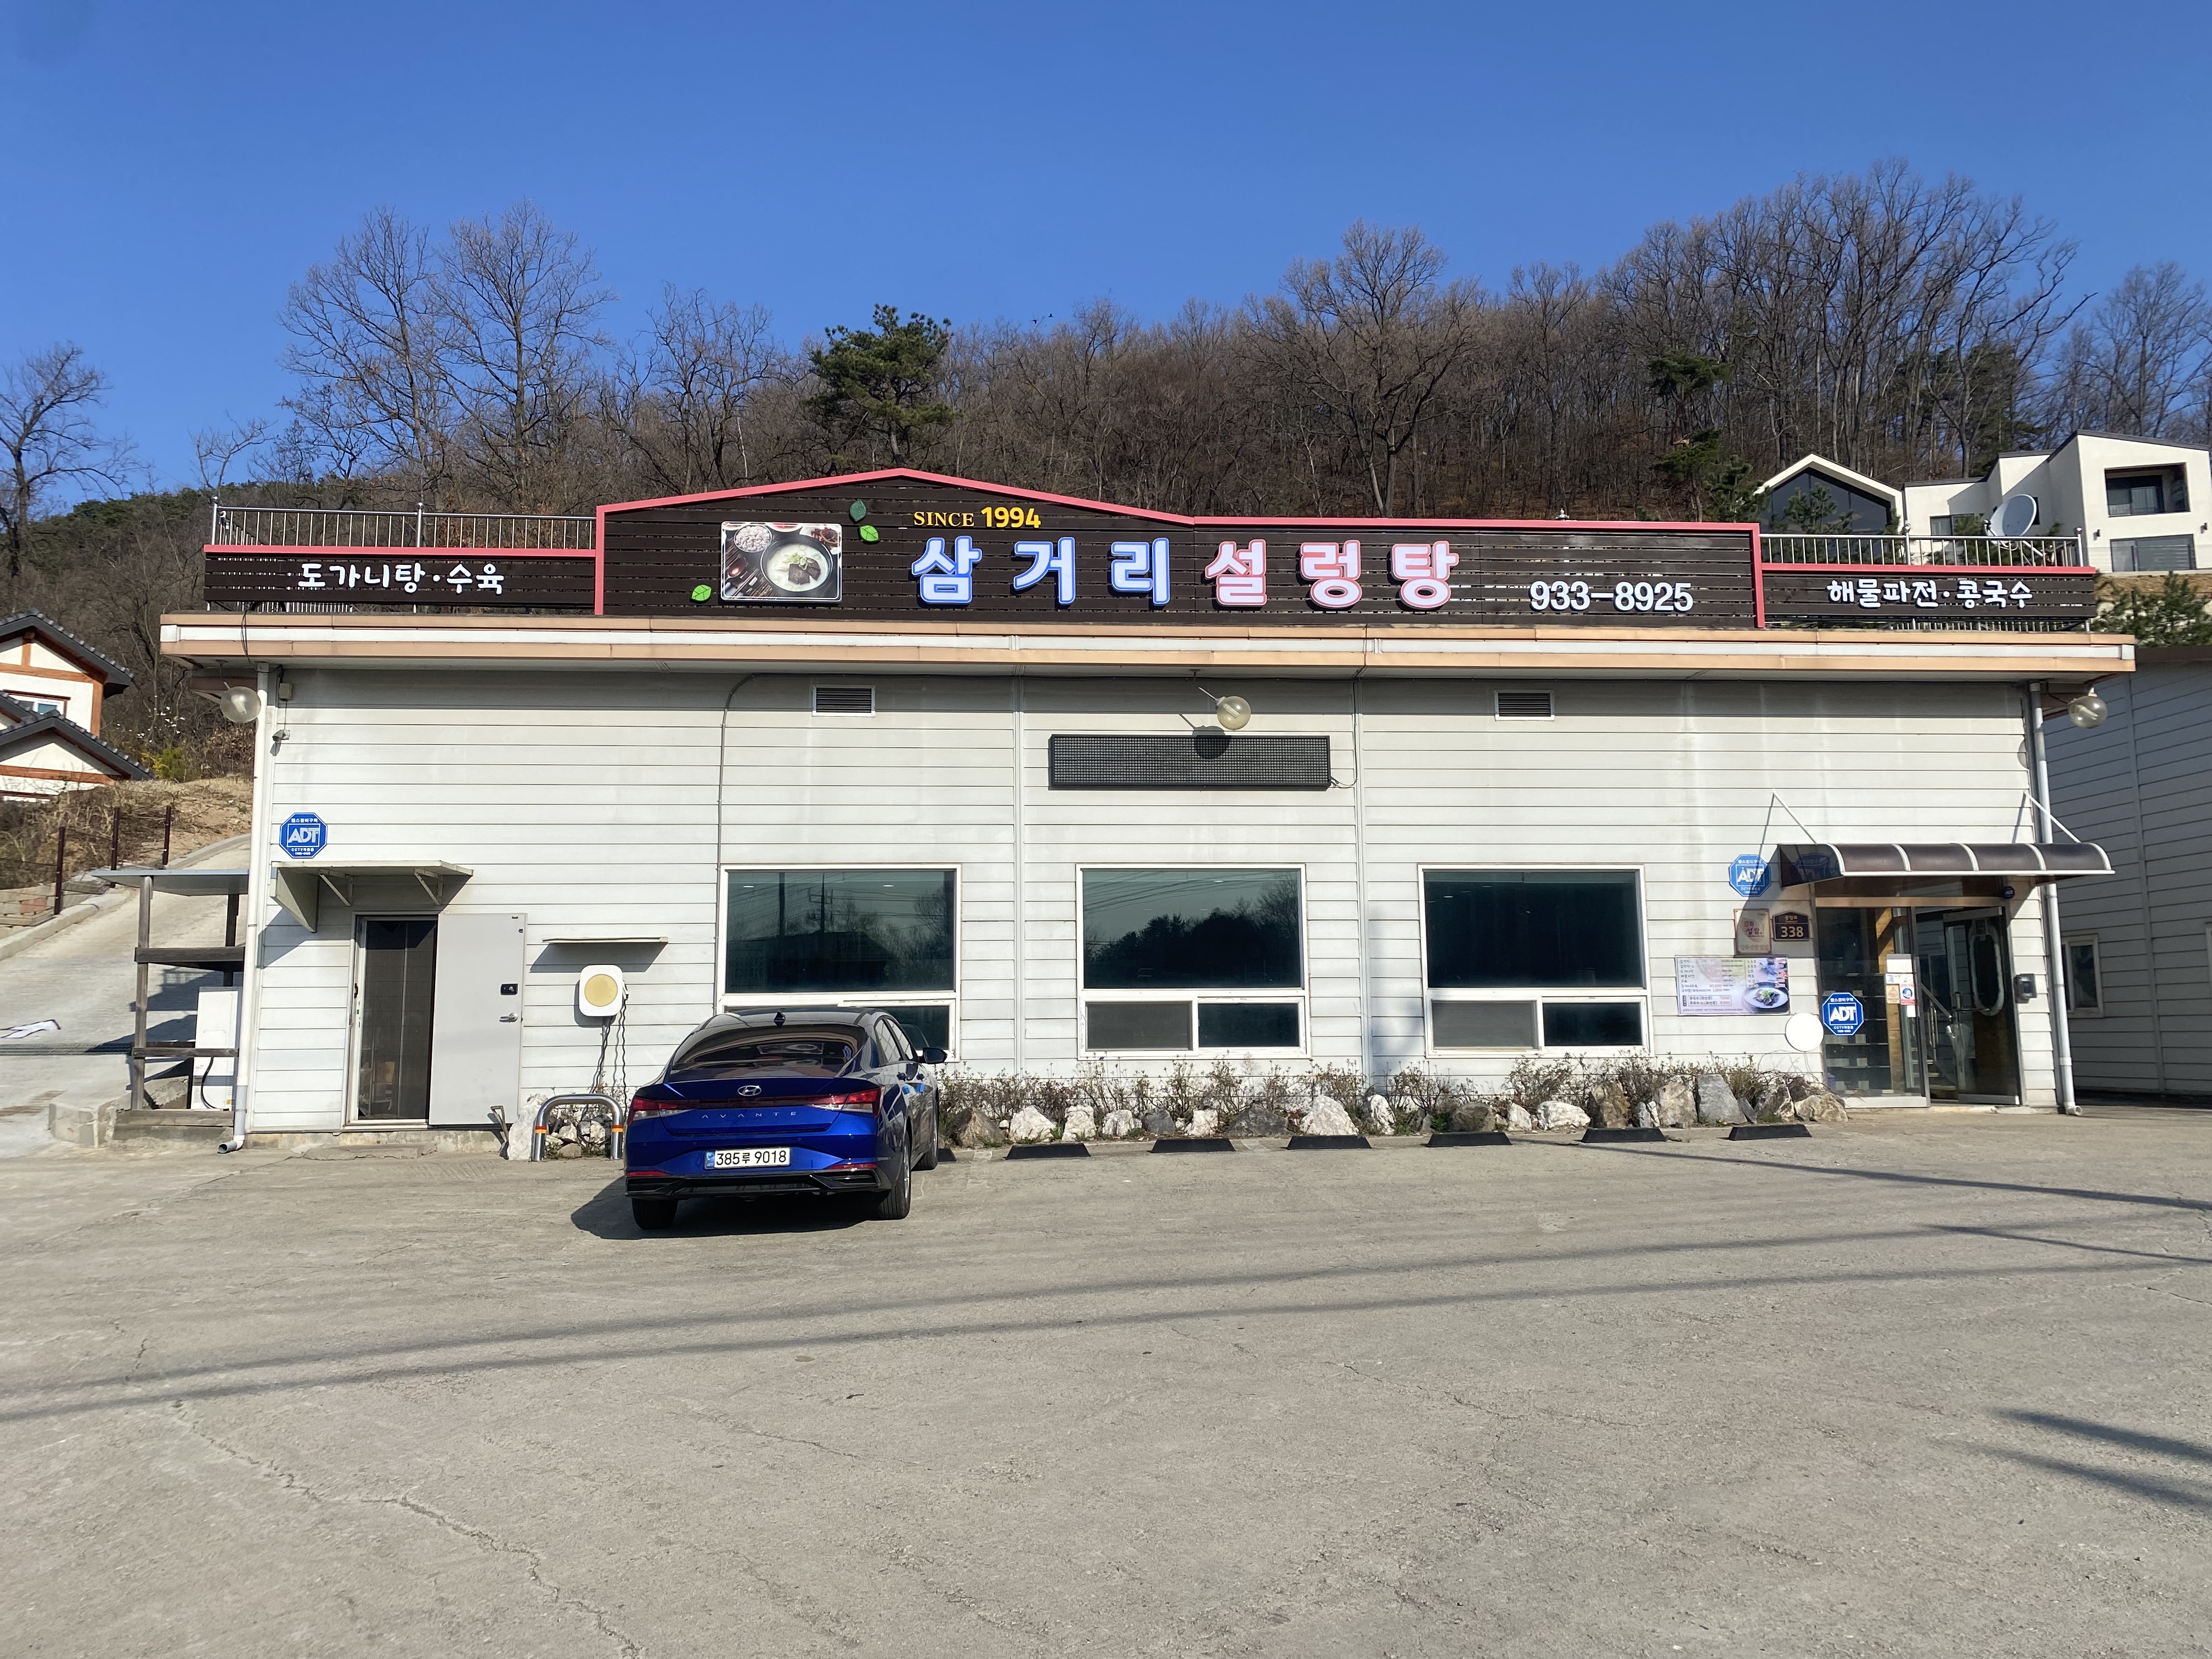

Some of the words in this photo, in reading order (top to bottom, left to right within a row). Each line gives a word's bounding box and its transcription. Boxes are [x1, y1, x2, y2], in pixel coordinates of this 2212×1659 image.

[913, 511, 974, 527] SINCE
[981, 507, 1041, 528] 1994
[1530, 580, 1694, 612] 933-8925
[287, 827, 319, 843] ADT
[1737, 867, 1765, 883] ADT
[1781, 926, 1804, 938] 338
[1830, 1006, 1857, 1022] ADT
[716, 1152, 751, 1166] 385루
[755, 1150, 787, 1164] 9018
